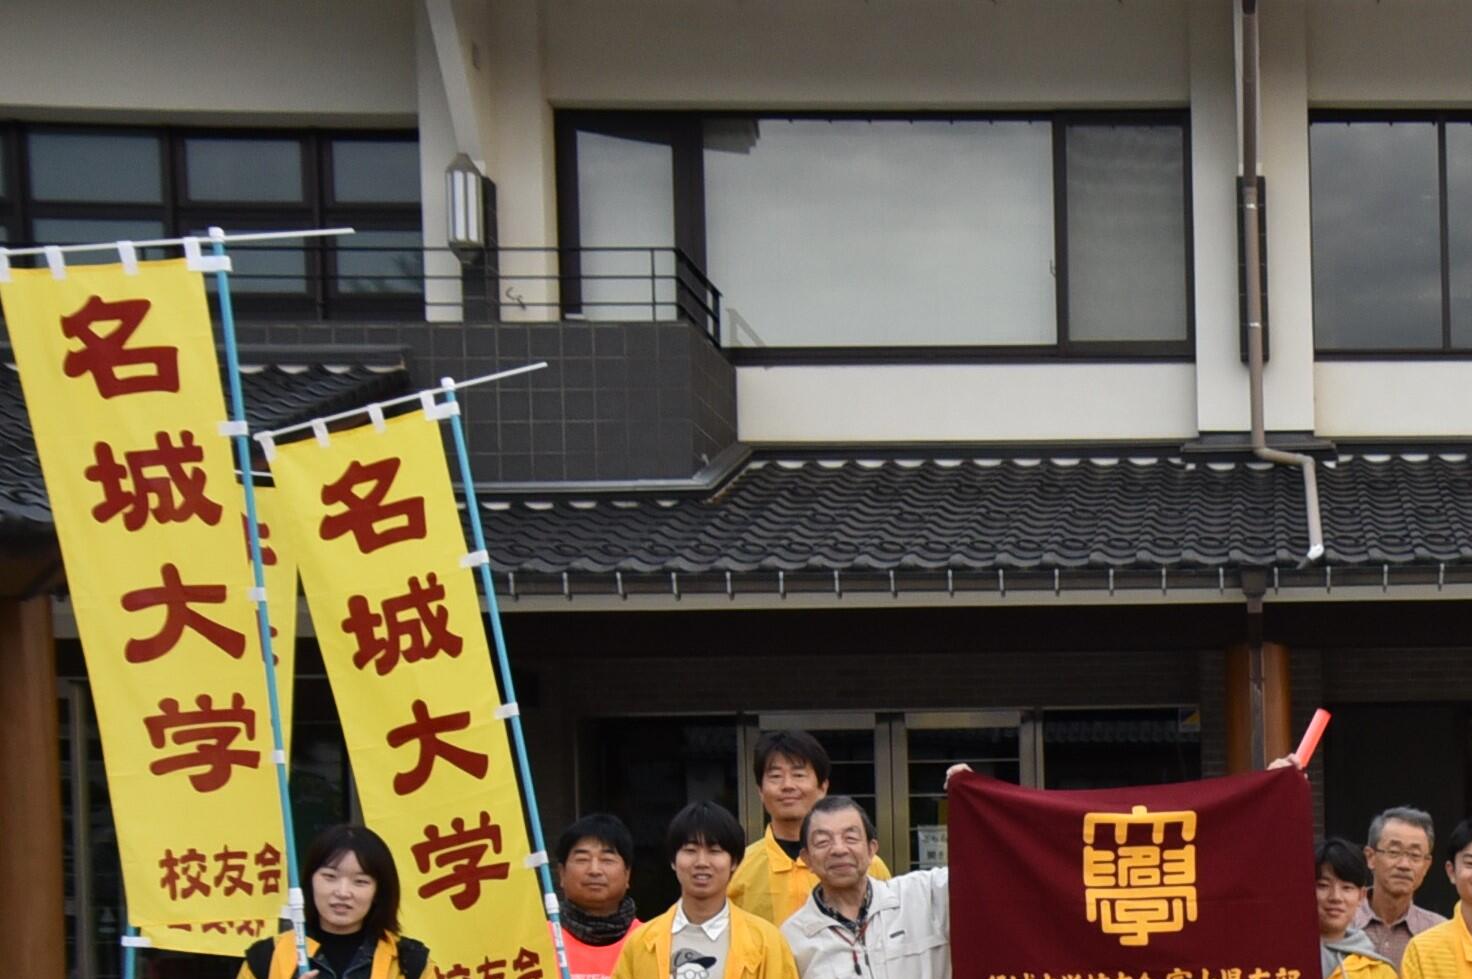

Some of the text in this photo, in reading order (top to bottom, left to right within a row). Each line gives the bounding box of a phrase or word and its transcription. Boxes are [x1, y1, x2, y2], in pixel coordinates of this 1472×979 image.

[61, 296, 261, 793] 名城大学
[319, 456, 510, 912] 名城大学
[158, 842, 281, 901] 校友会
